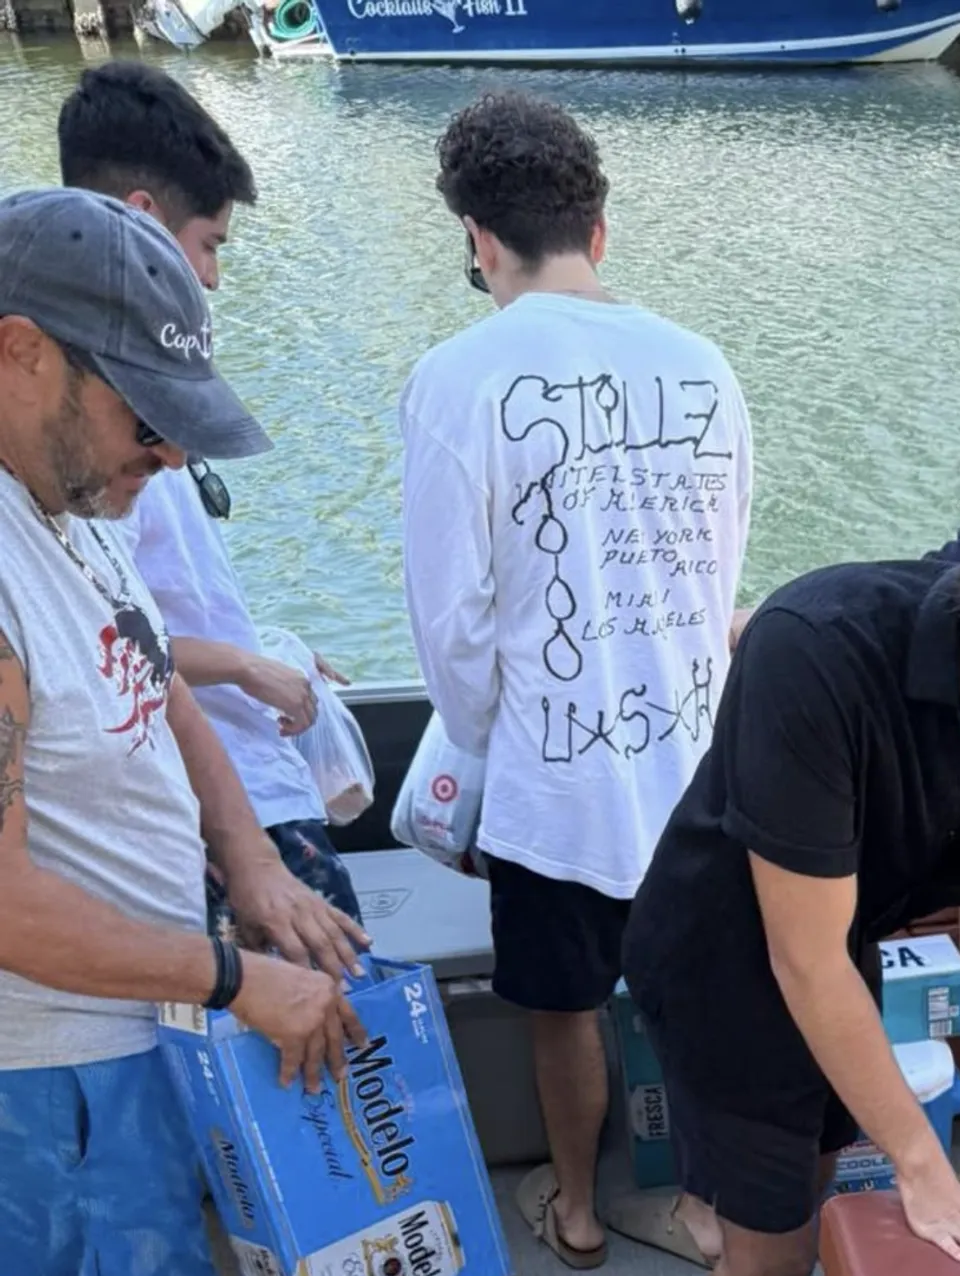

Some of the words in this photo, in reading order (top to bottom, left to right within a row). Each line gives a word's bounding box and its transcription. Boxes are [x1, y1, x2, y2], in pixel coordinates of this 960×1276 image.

[653, 528, 713, 545] YORK
[403, 982, 428, 1018] 24
[346, 1035, 416, 1177] Modelo
[643, 1086, 669, 1137] FRESCA
